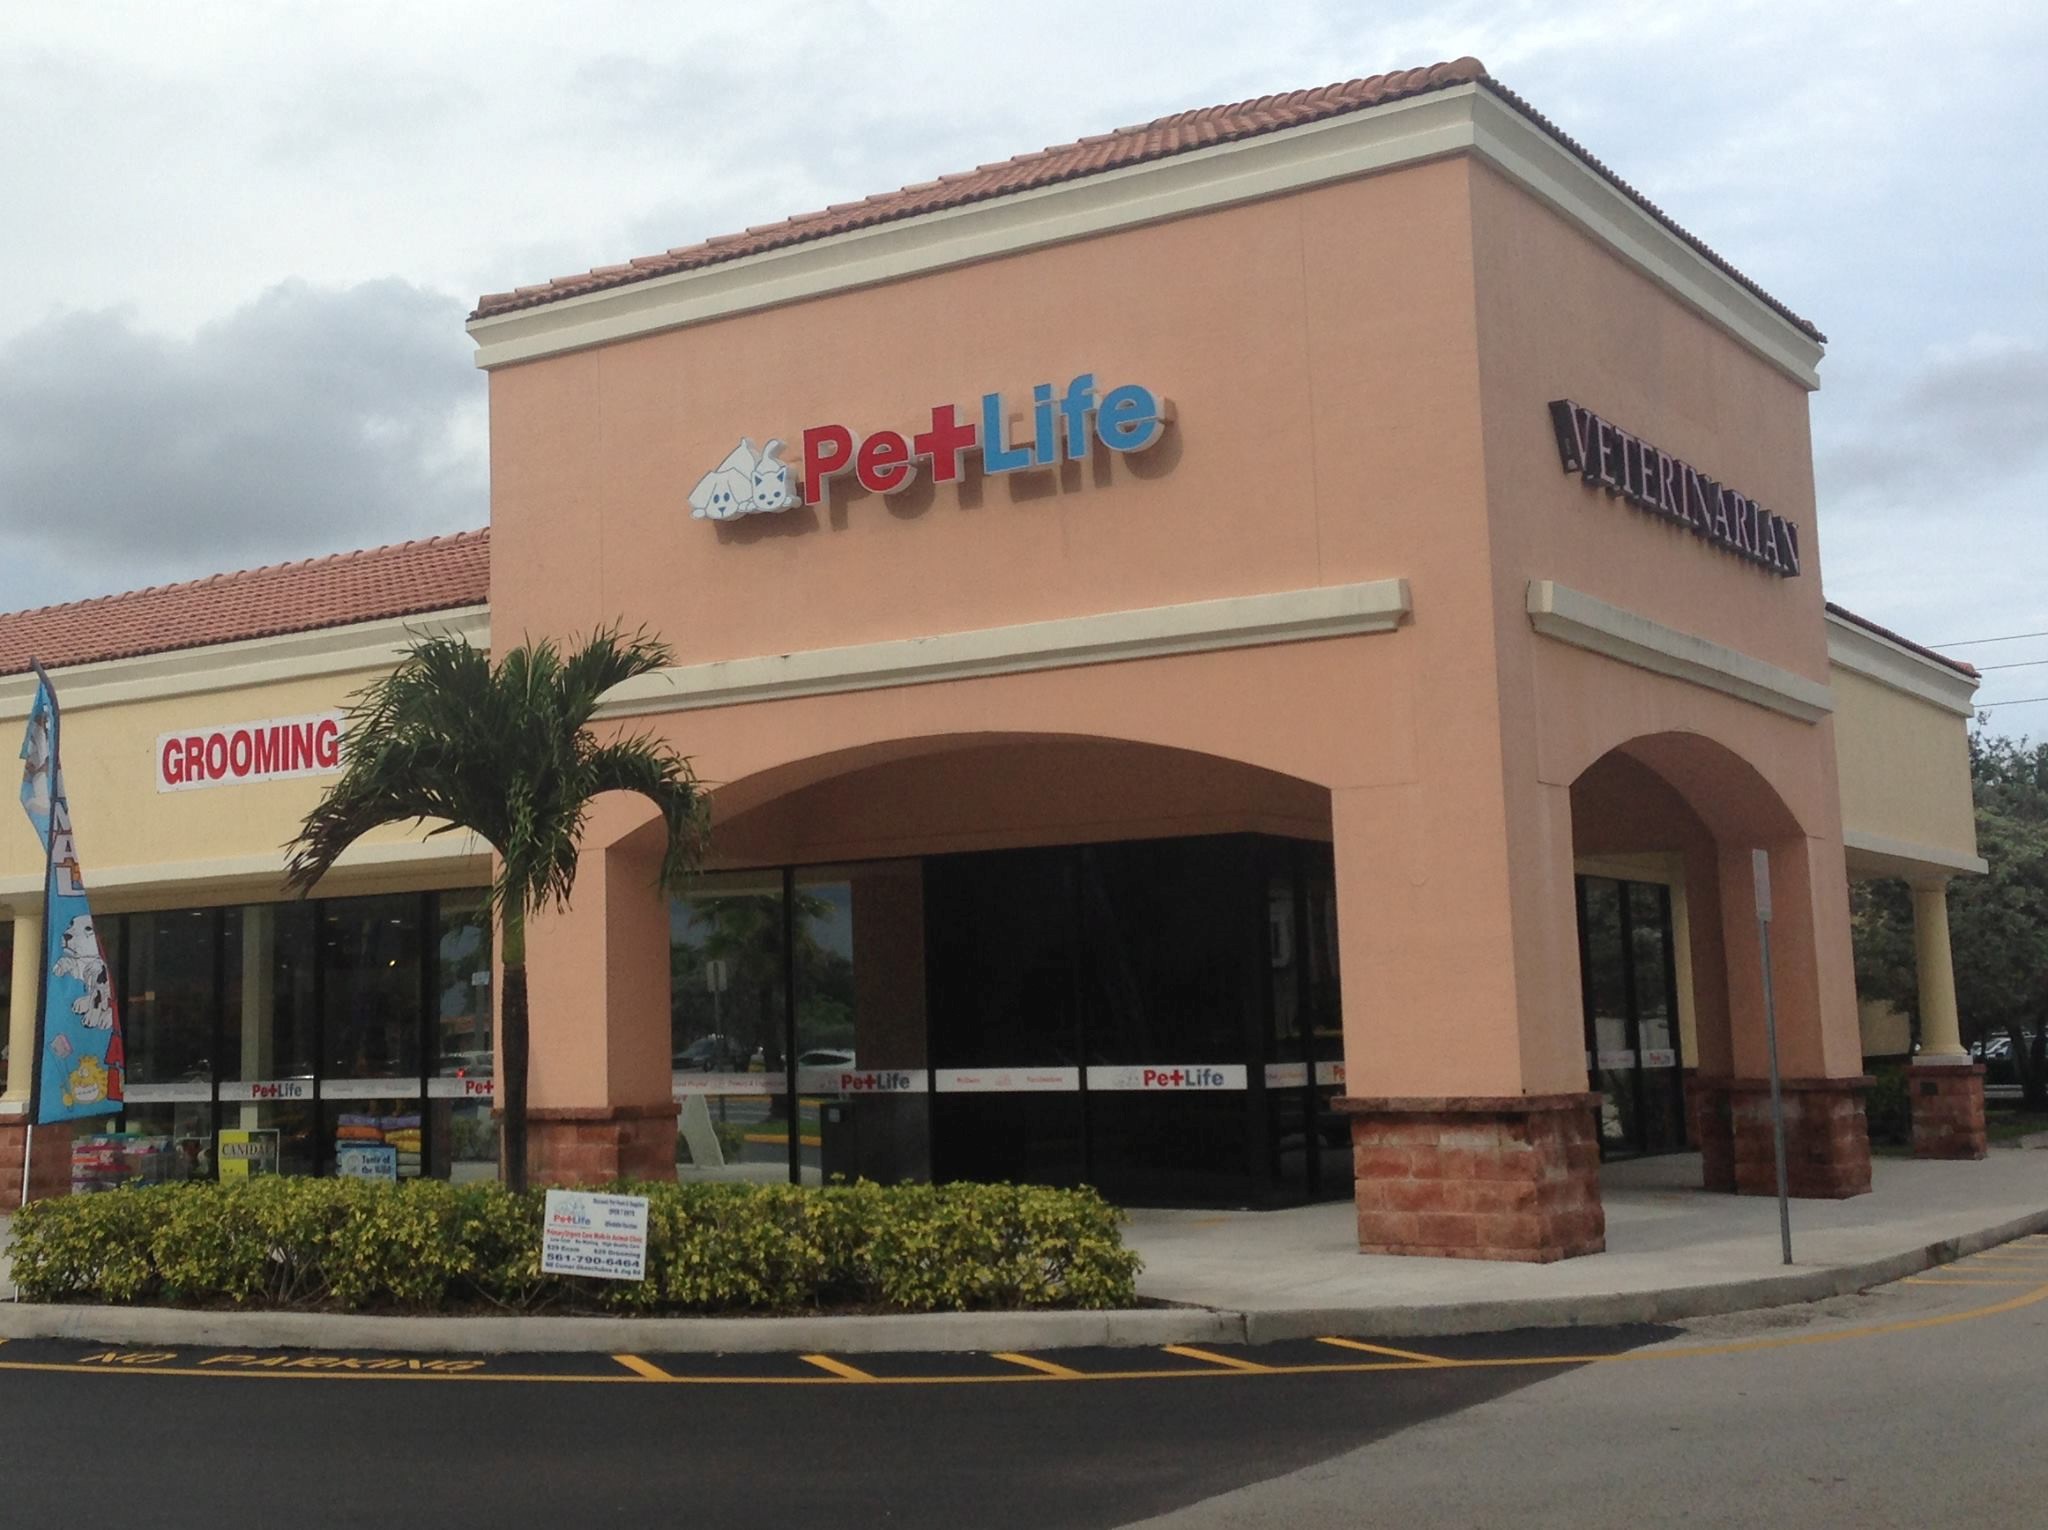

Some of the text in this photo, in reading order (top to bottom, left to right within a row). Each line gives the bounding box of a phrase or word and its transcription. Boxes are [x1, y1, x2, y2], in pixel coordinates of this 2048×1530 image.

[803, 373, 1160, 505] PetLife
[1551, 399, 1799, 576] VETERINARIAN
[162, 719, 339, 785] GROOMING
[841, 1072, 910, 1090] PetLife
[1143, 1068, 1224, 1087] PetLife
[252, 1082, 303, 1099] PetLife
[553, 1214, 591, 1226] PetLife
[547, 1253, 639, 1268] 561-790-6464
[78, 1351, 486, 1372] NO PARKING
